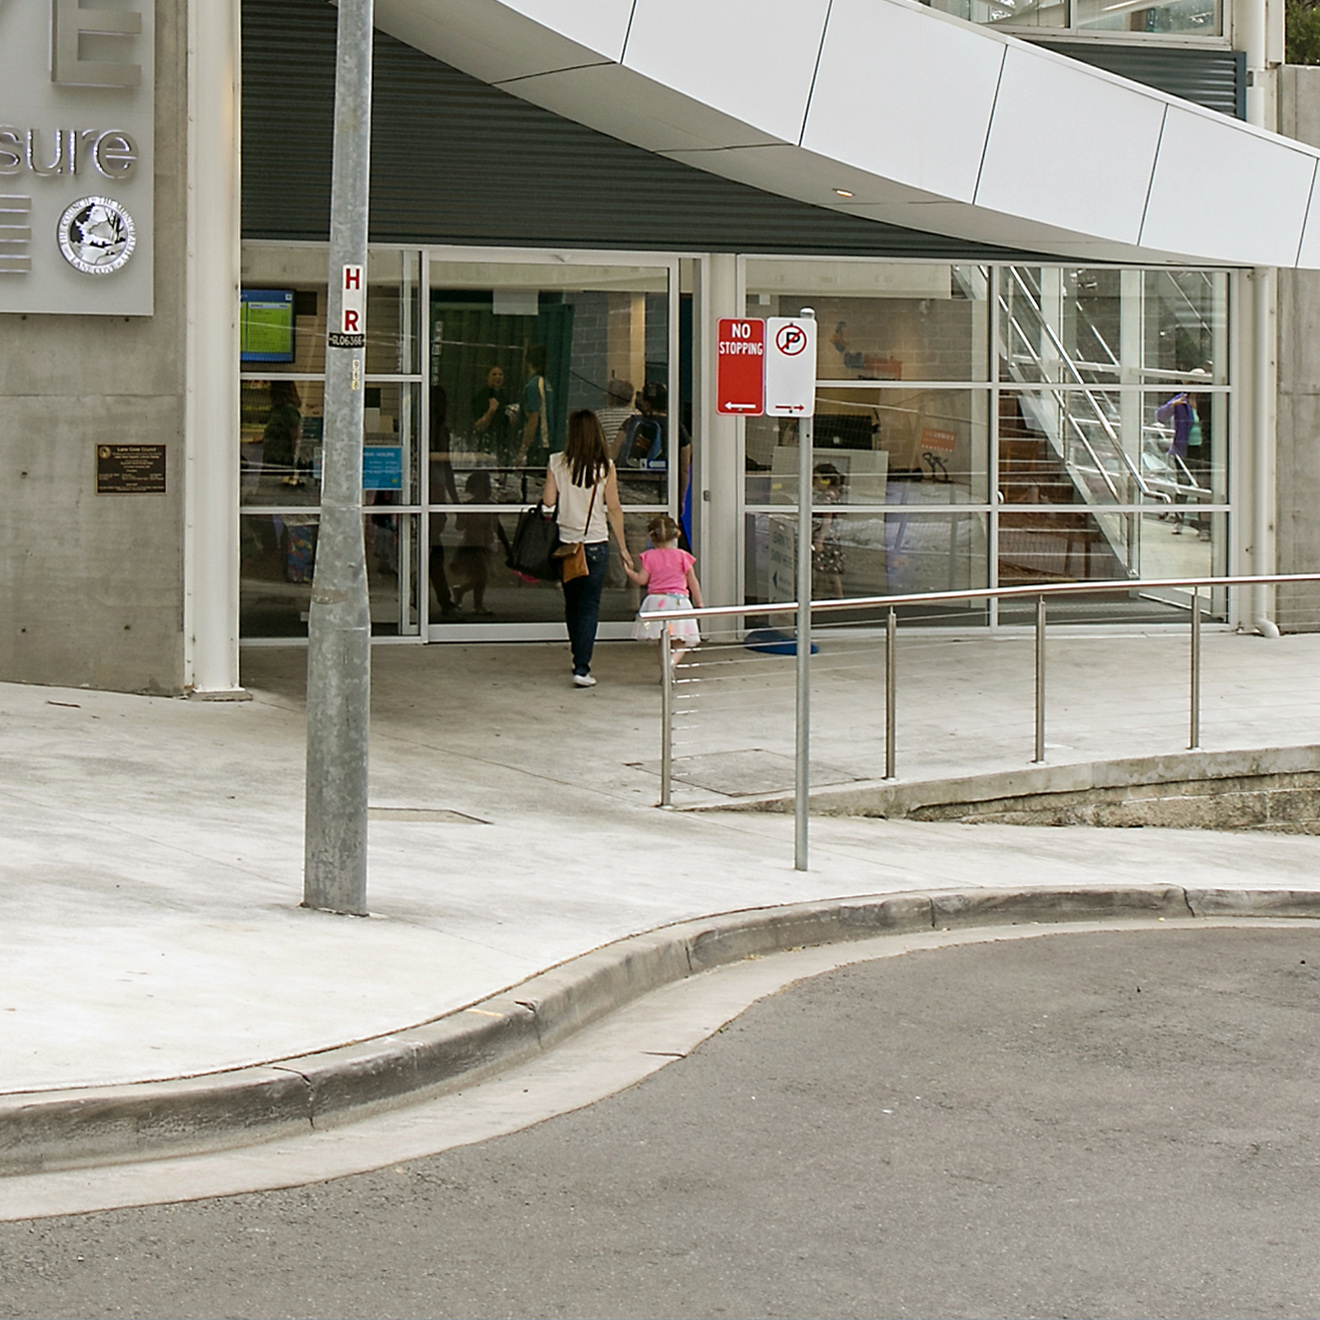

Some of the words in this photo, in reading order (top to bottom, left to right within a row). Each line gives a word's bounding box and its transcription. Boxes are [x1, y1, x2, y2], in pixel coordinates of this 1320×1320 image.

[345, 268, 360, 290] H
[344, 310, 359, 331] R
[731, 323, 751, 339] NO
[719, 341, 763, 356] STOPPING
